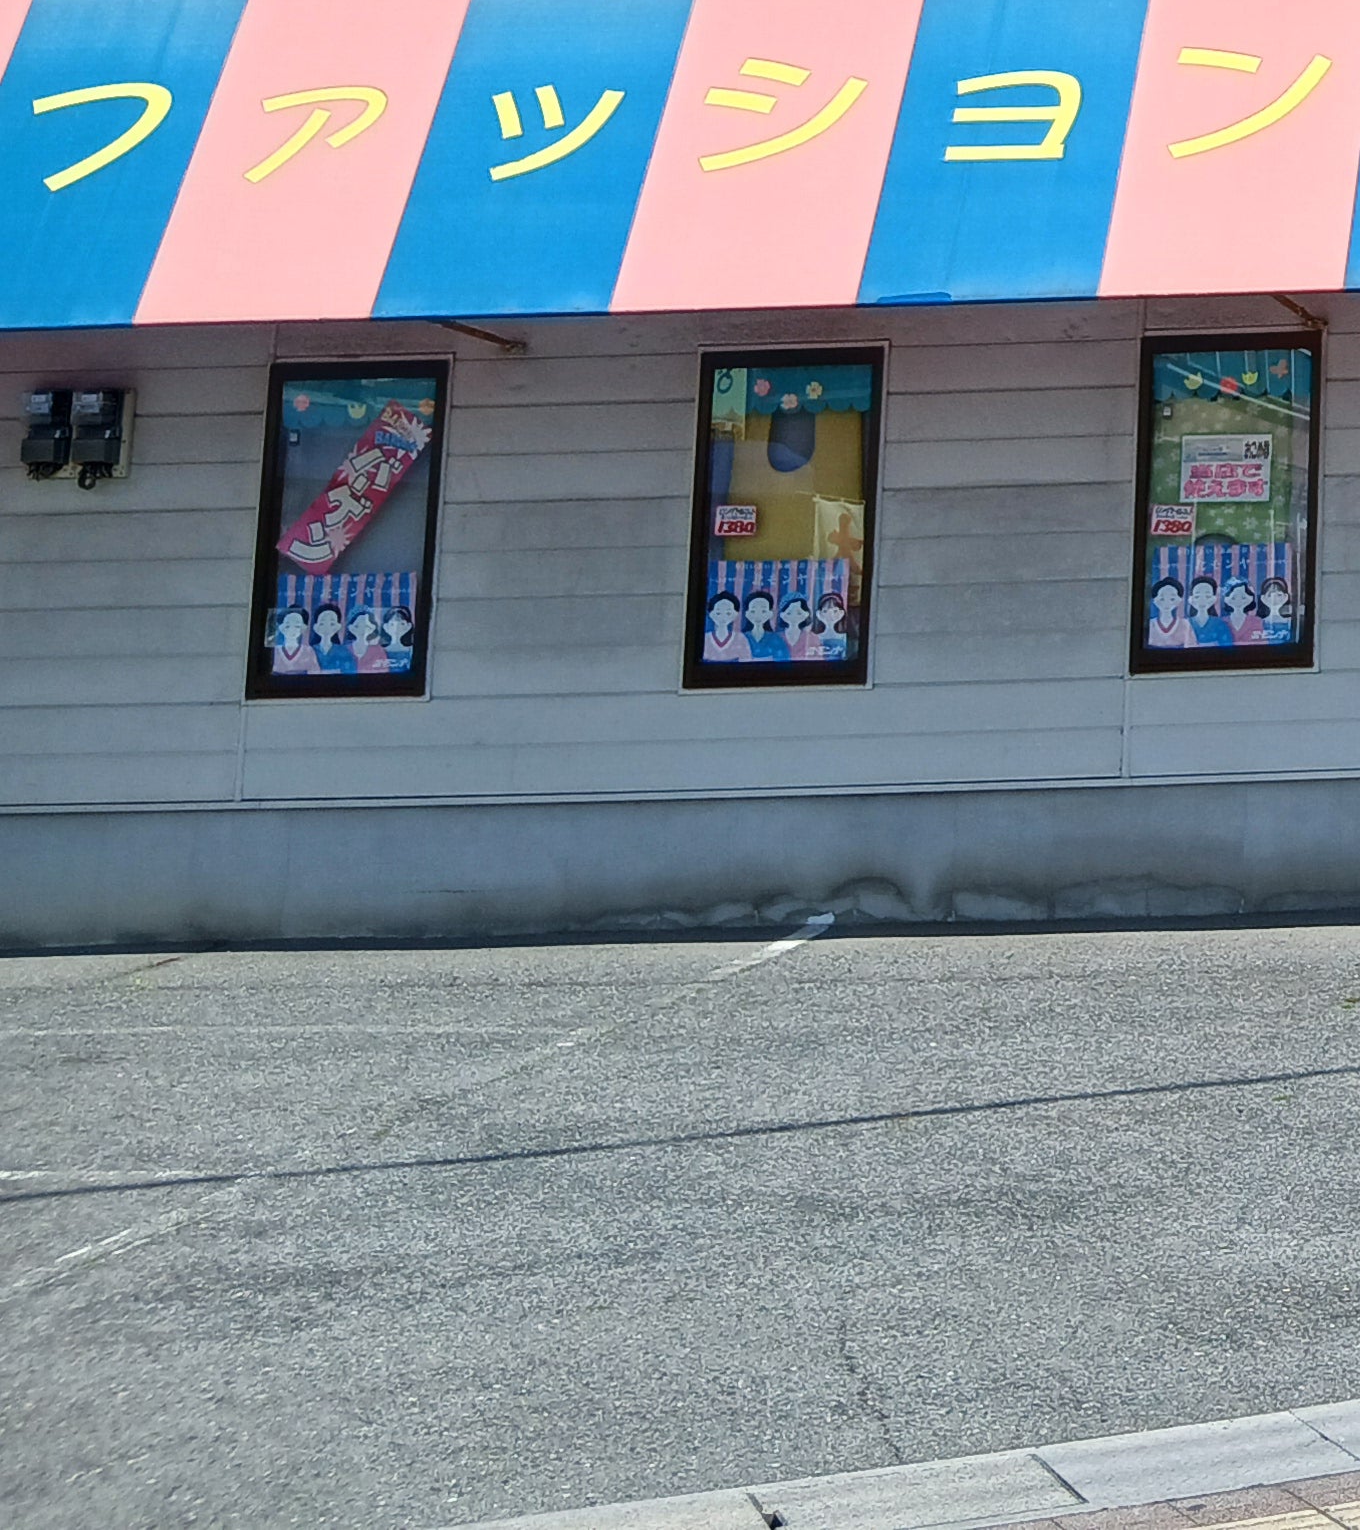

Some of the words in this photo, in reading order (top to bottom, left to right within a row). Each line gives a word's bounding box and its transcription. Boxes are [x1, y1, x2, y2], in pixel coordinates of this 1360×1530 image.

[1190, 463, 1263, 479] 当店で
[1183, 479, 1268, 499] 使えます
[287, 447, 404, 564] バーゲン
[717, 520, 756, 534] 1380
[1152, 520, 1193, 533] 1380
